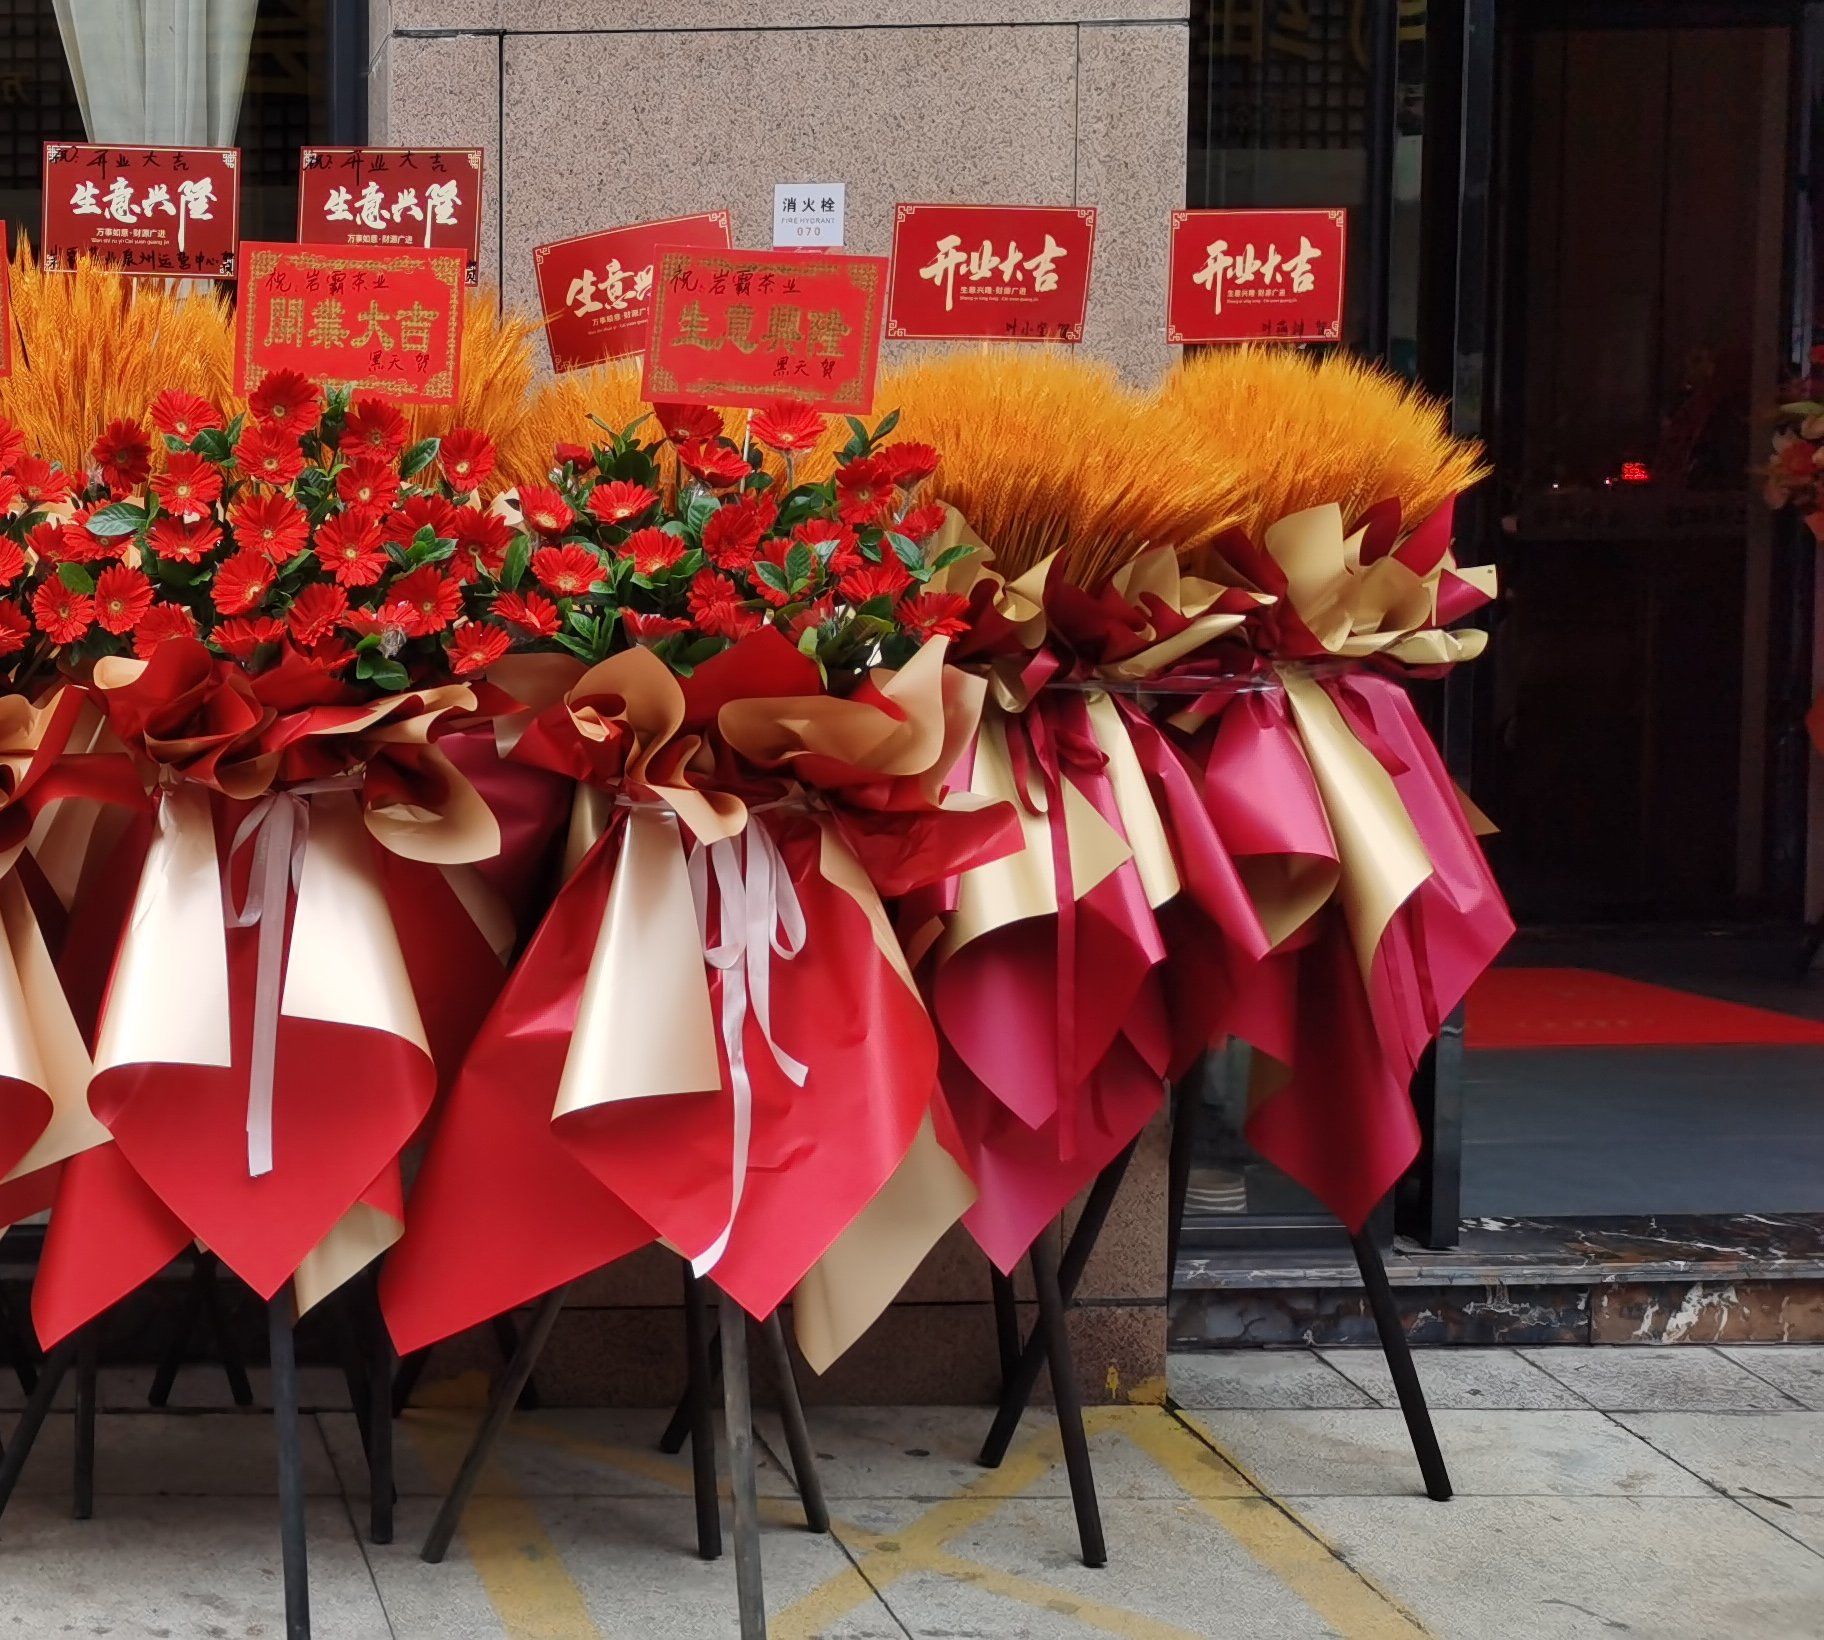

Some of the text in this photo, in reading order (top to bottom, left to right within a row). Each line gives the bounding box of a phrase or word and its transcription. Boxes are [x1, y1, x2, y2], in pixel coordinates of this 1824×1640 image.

[69, 176, 218, 253] 生意兴隆
[323, 179, 463, 249] 生意兴隆
[781, 217, 836, 225] FIRE HYDRANT
[782, 197, 836, 213] 消火栓
[797, 227, 821, 236] 070
[919, 233, 1068, 312] 开业大吉
[1192, 235, 1322, 316] 开业大吉
[263, 297, 440, 352] 開業大吉
